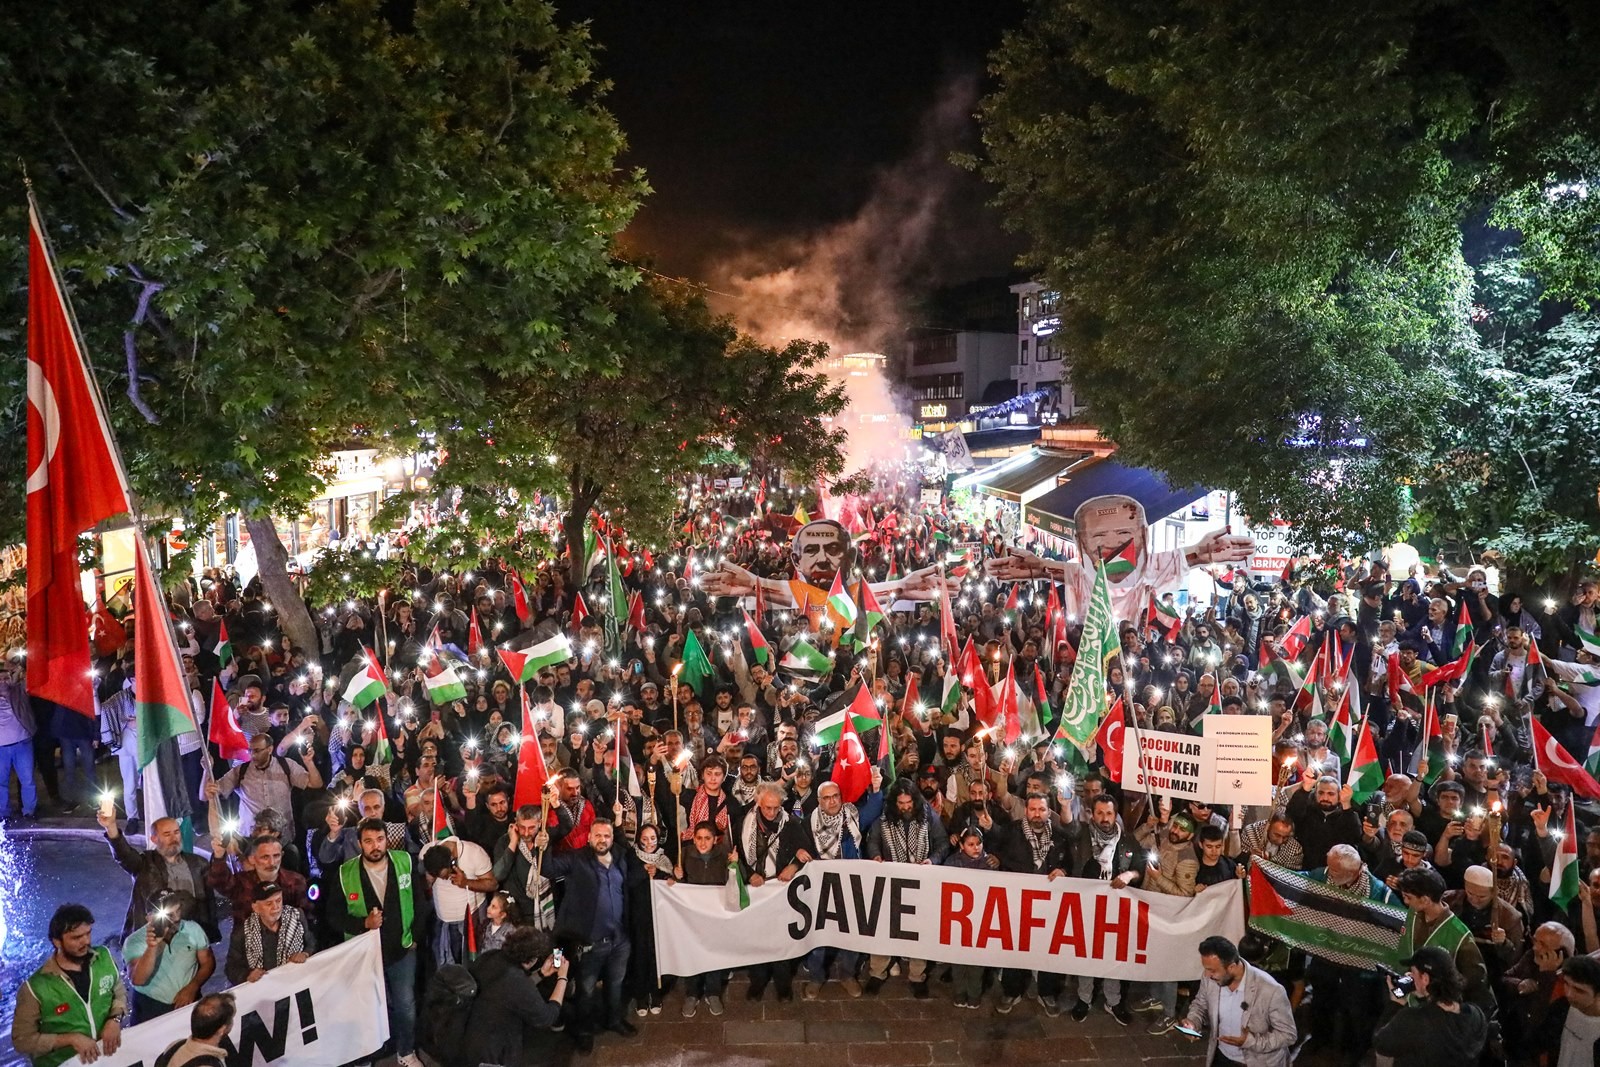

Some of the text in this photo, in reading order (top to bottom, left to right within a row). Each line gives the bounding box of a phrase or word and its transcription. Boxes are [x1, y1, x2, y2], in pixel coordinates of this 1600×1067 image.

[1255, 531, 1275, 540] TOP
[1140, 736, 1201, 757] ÇOCUKLAR
[787, 872, 1150, 964] SAVE RAFAH!
